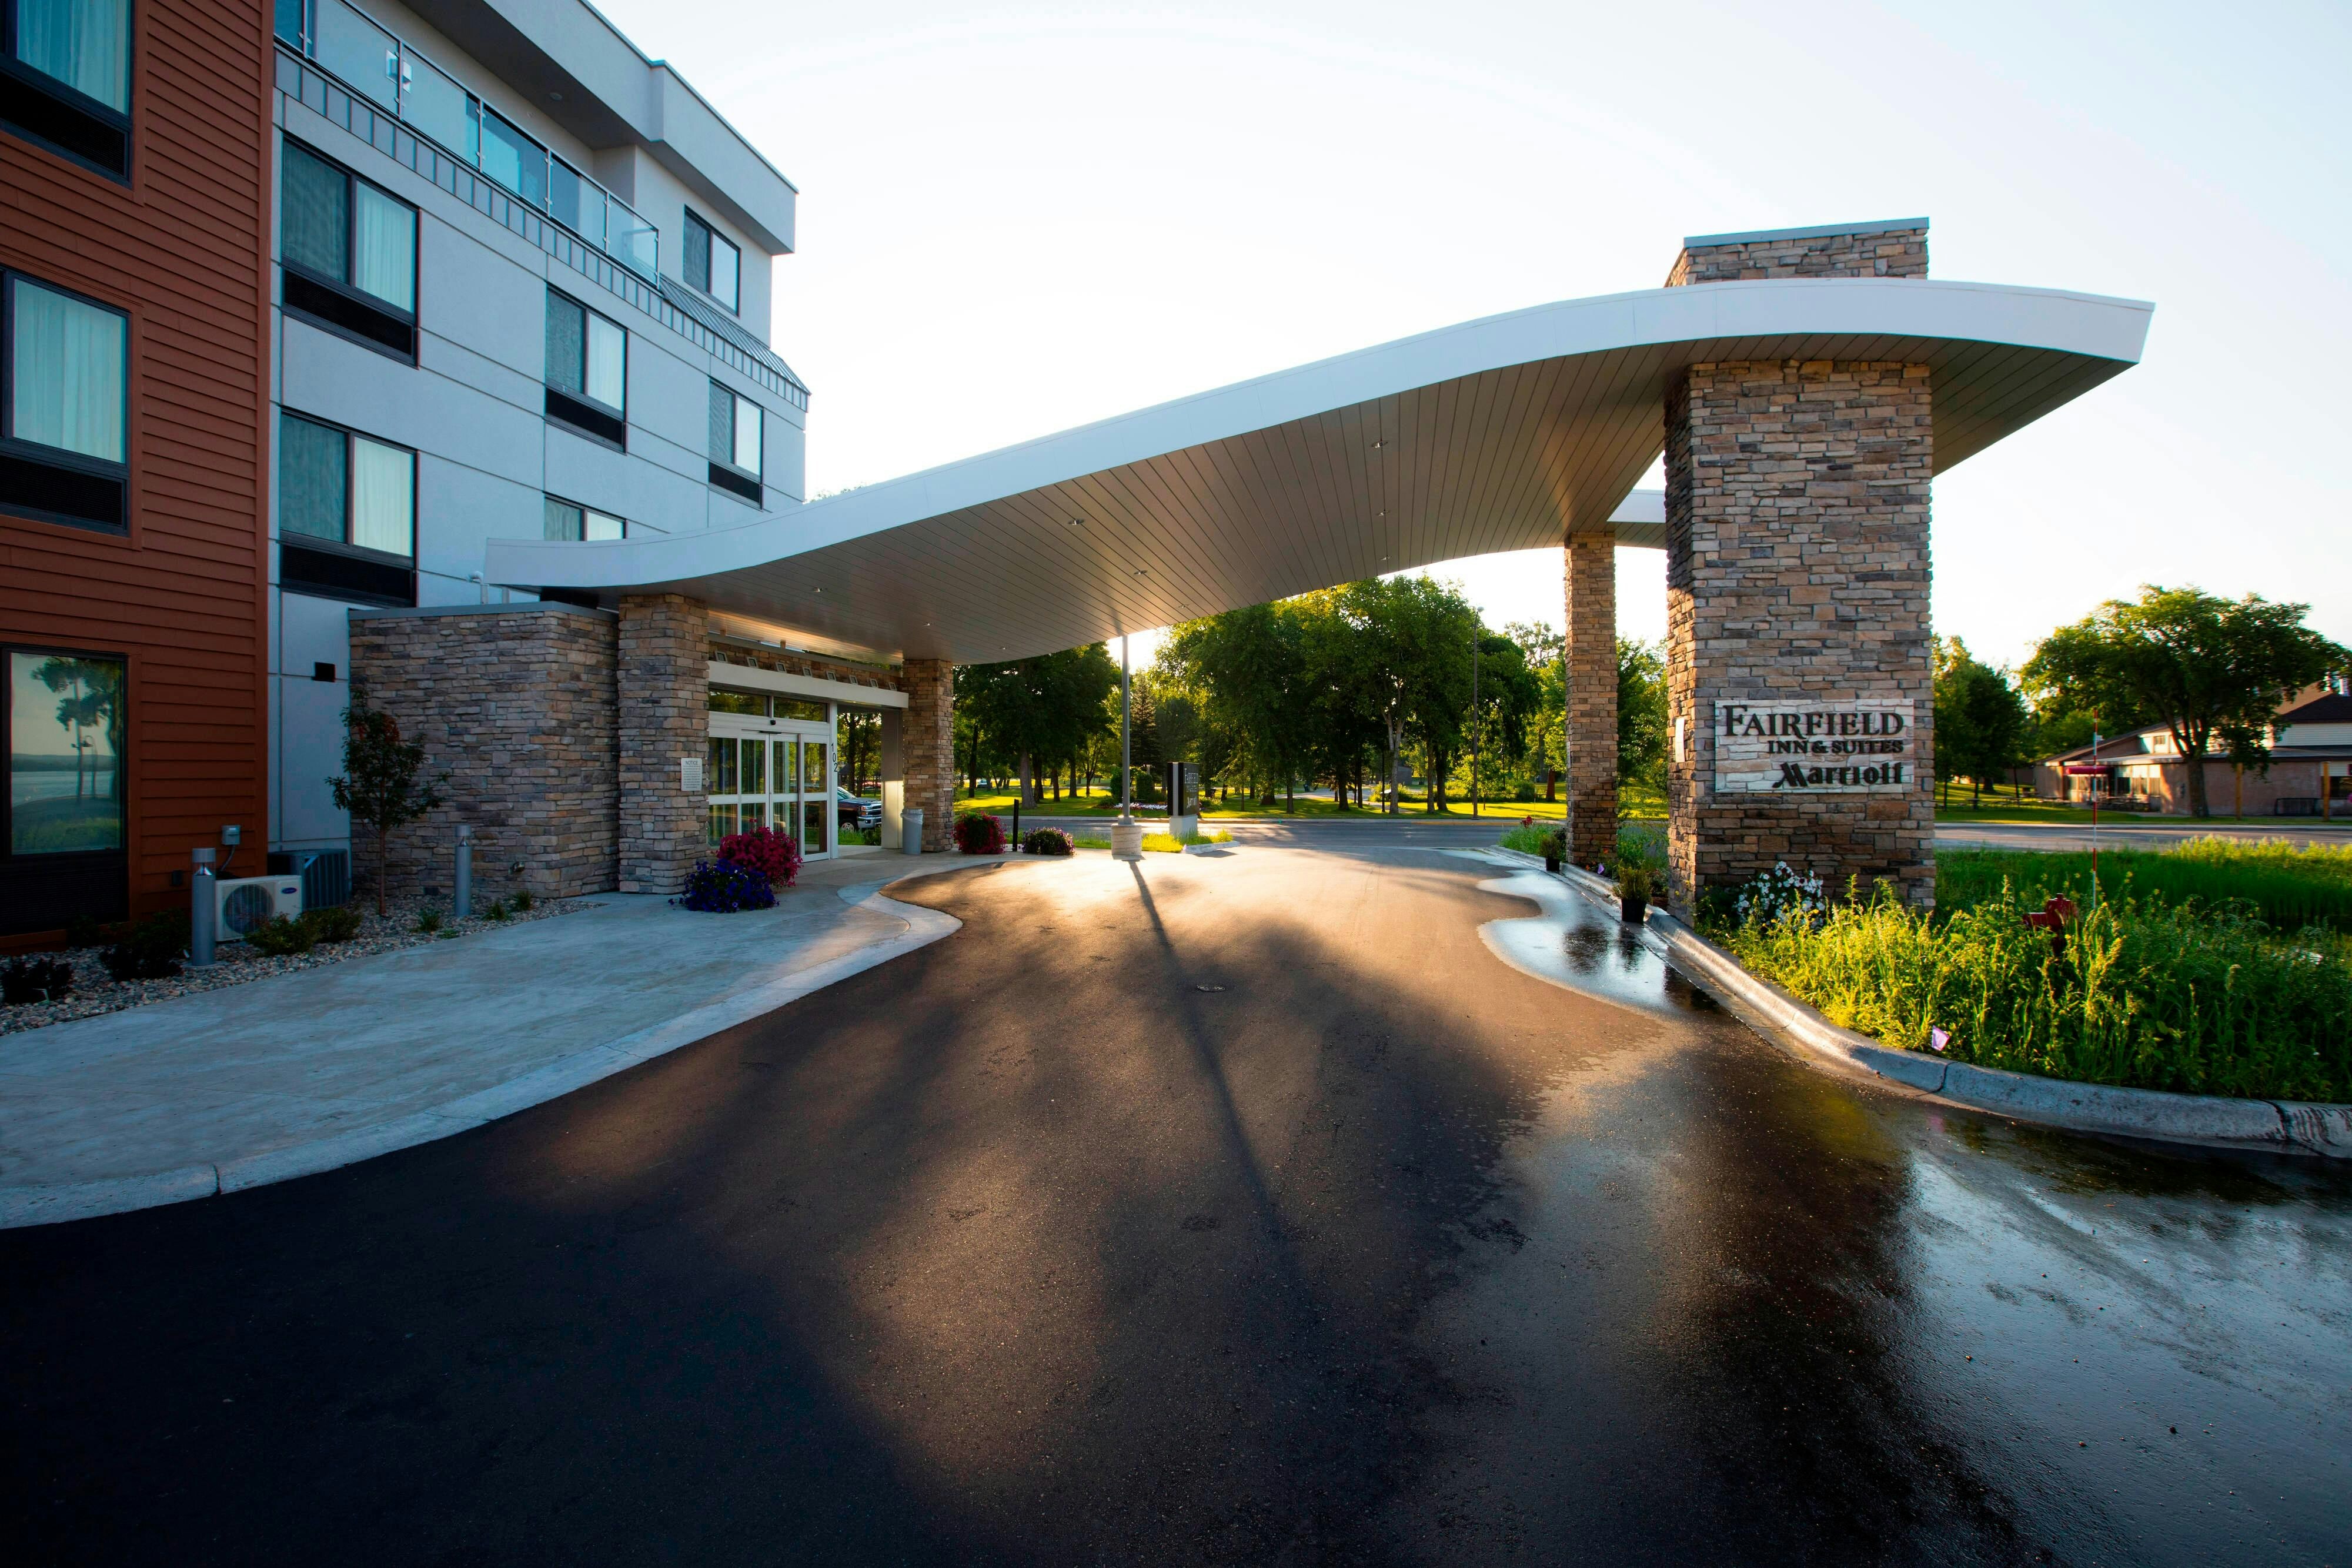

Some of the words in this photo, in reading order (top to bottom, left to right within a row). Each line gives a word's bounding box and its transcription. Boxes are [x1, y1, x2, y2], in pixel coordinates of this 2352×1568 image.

[1723, 705, 1904, 739] FAIRFIELD
[1768, 740, 1809, 754] INN
[1812, 740, 1829, 754] &
[1831, 740, 1904, 754] SUITES
[1772, 762, 1904, 788] Marriott
